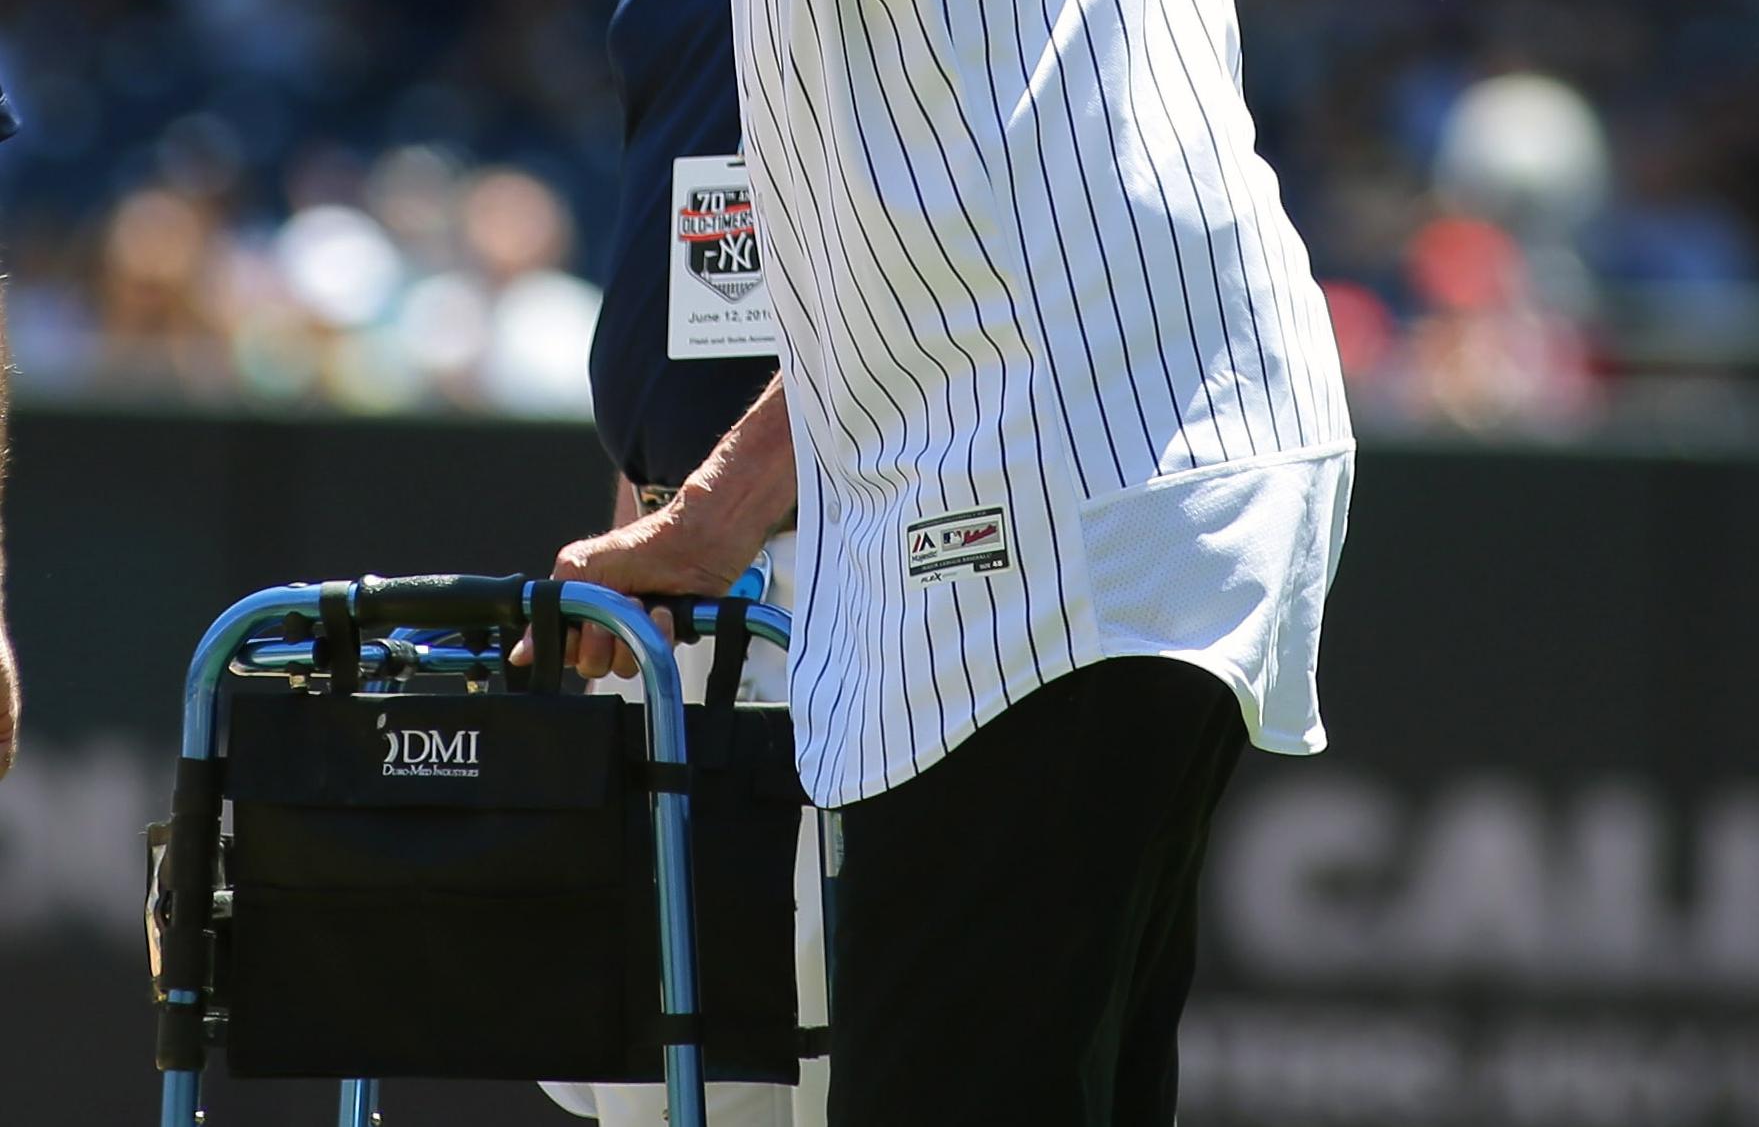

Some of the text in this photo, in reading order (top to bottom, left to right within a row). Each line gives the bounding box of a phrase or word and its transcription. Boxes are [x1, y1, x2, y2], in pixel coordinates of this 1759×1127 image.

[697, 192, 725, 214] 70
[718, 232, 753, 272] NY
[688, 312, 720, 324] June
[401, 730, 480, 764] DMI
